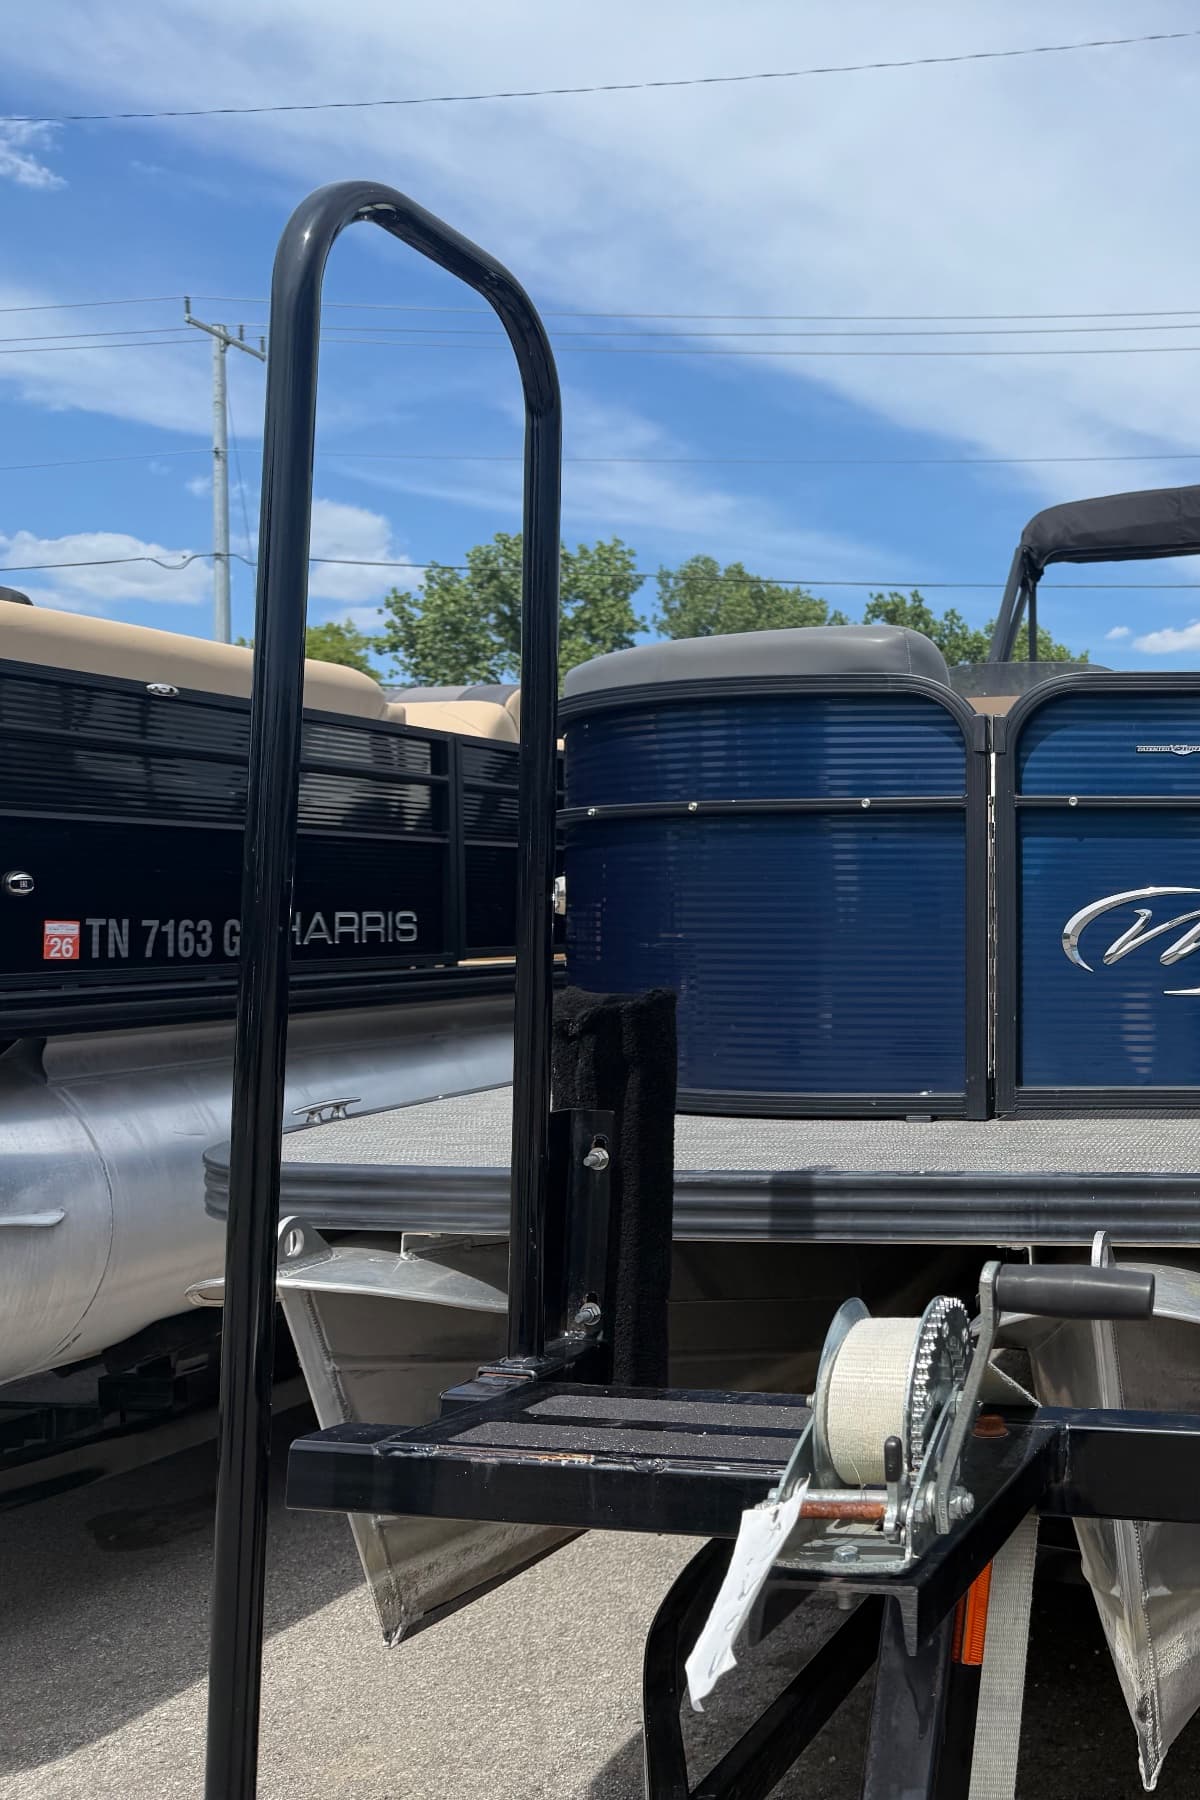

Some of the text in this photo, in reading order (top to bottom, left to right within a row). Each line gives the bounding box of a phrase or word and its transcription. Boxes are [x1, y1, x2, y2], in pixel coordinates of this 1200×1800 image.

[49, 937, 74, 957] 26
[86, 918, 129, 958] TN
[141, 919, 213, 957] 7163
